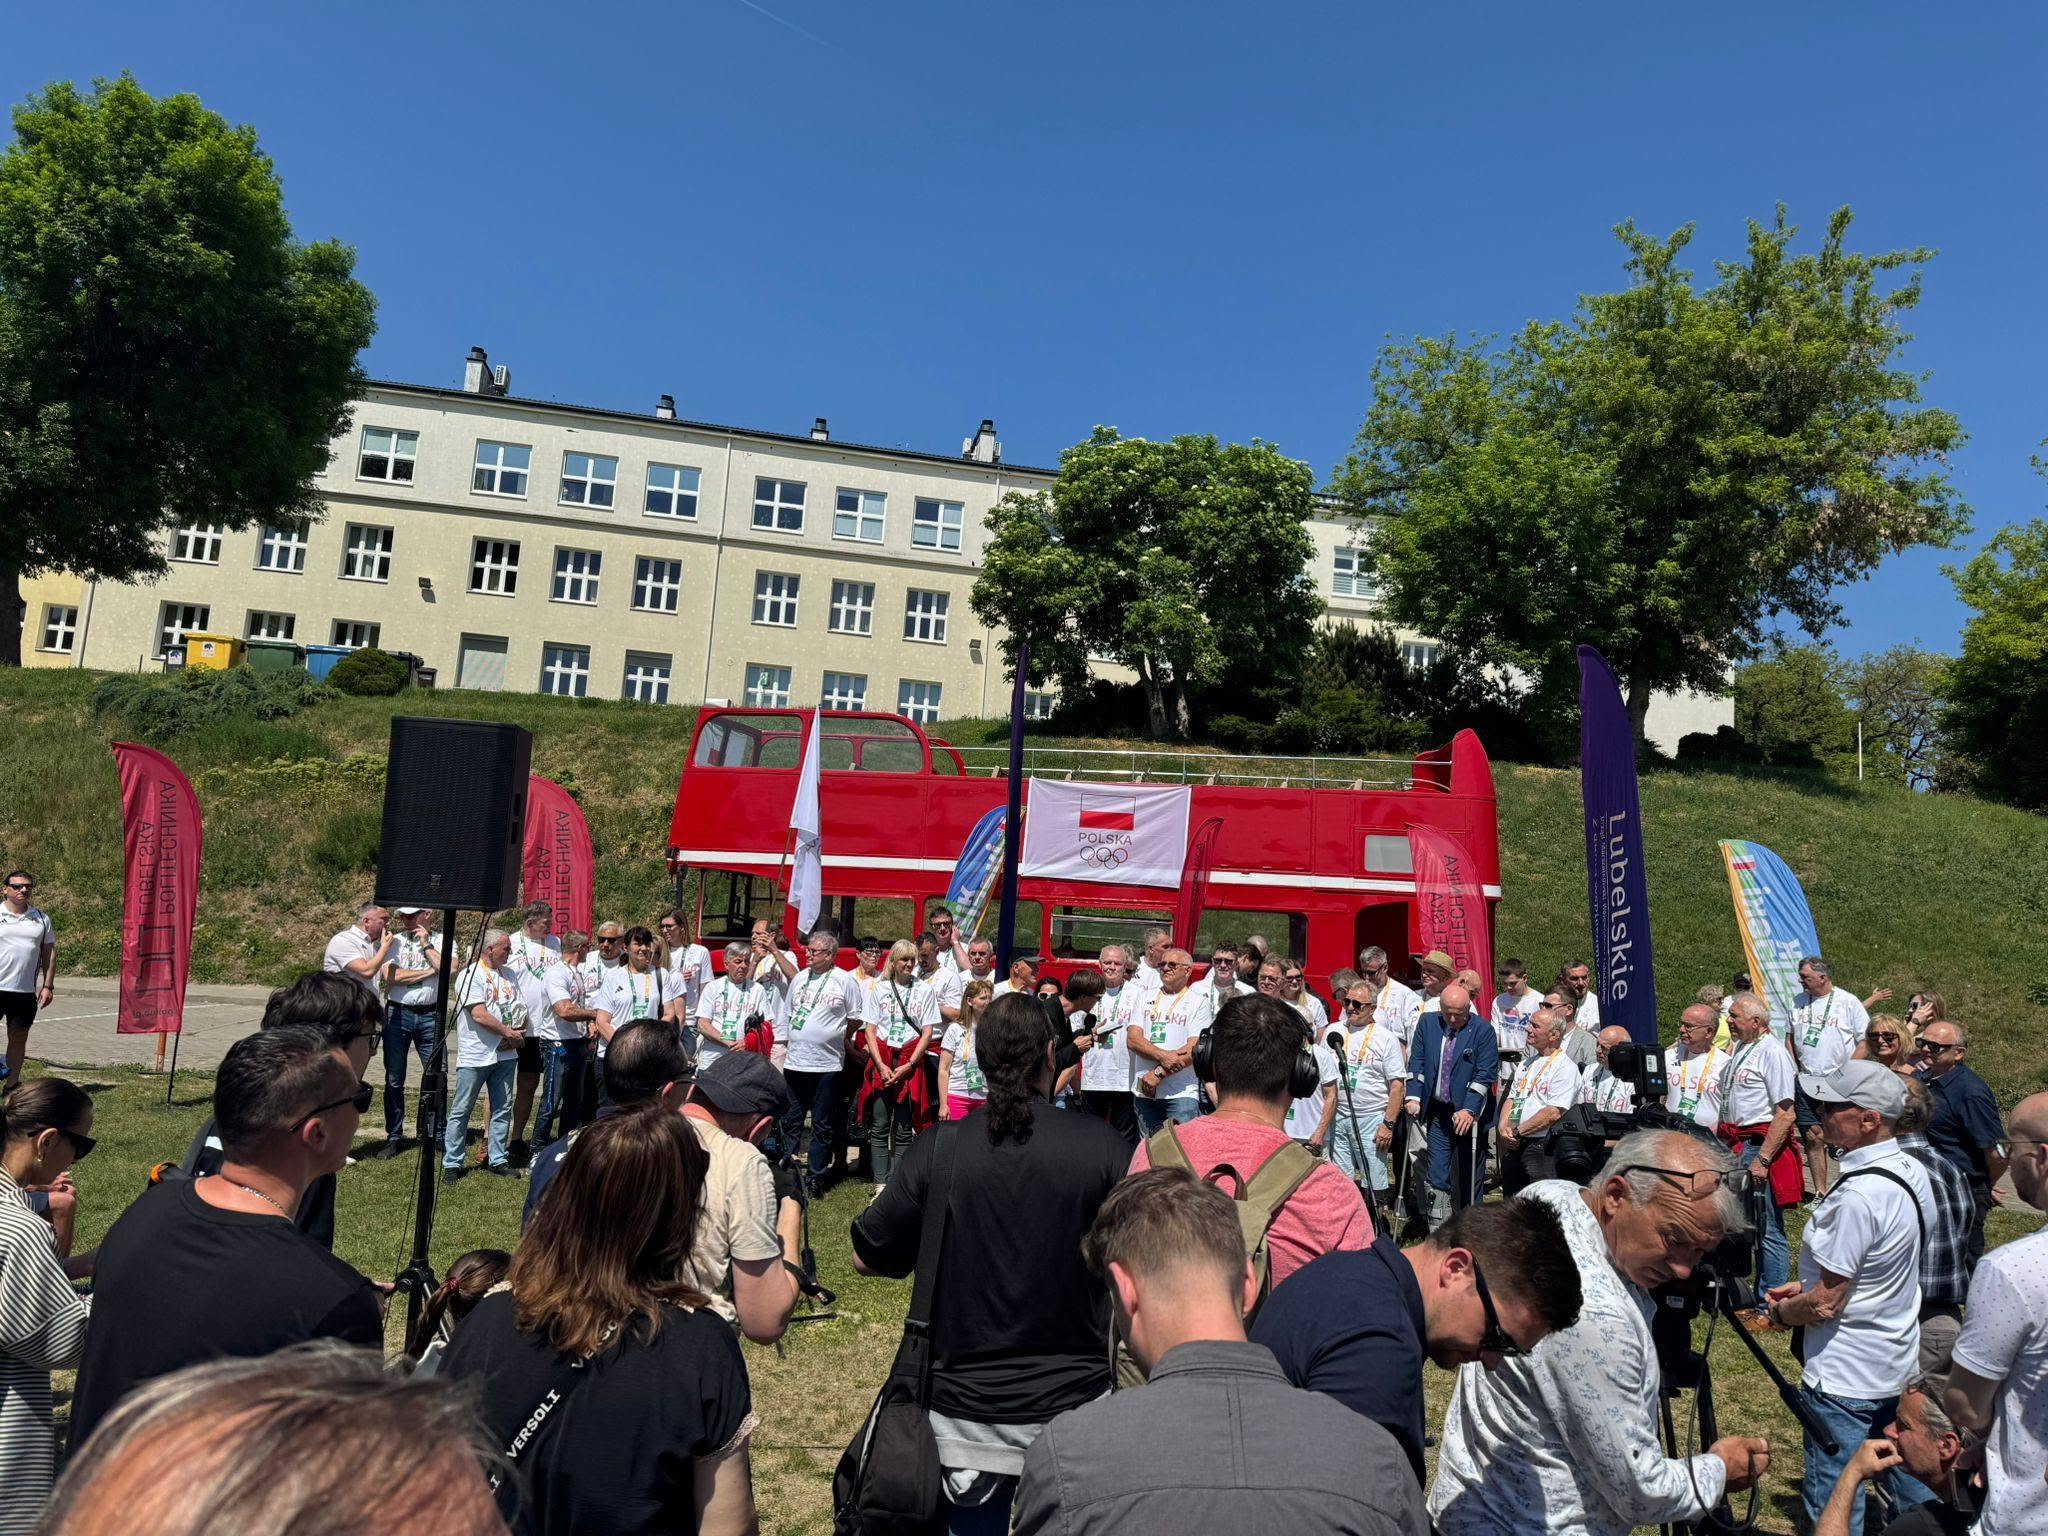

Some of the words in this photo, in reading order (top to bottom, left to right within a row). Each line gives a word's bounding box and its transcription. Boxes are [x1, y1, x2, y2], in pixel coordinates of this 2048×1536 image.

[1078, 832, 1132, 846] POLSKA
[1609, 810, 1634, 1000] Lubelskie
[506, 1389, 561, 1459] VERSOLI
